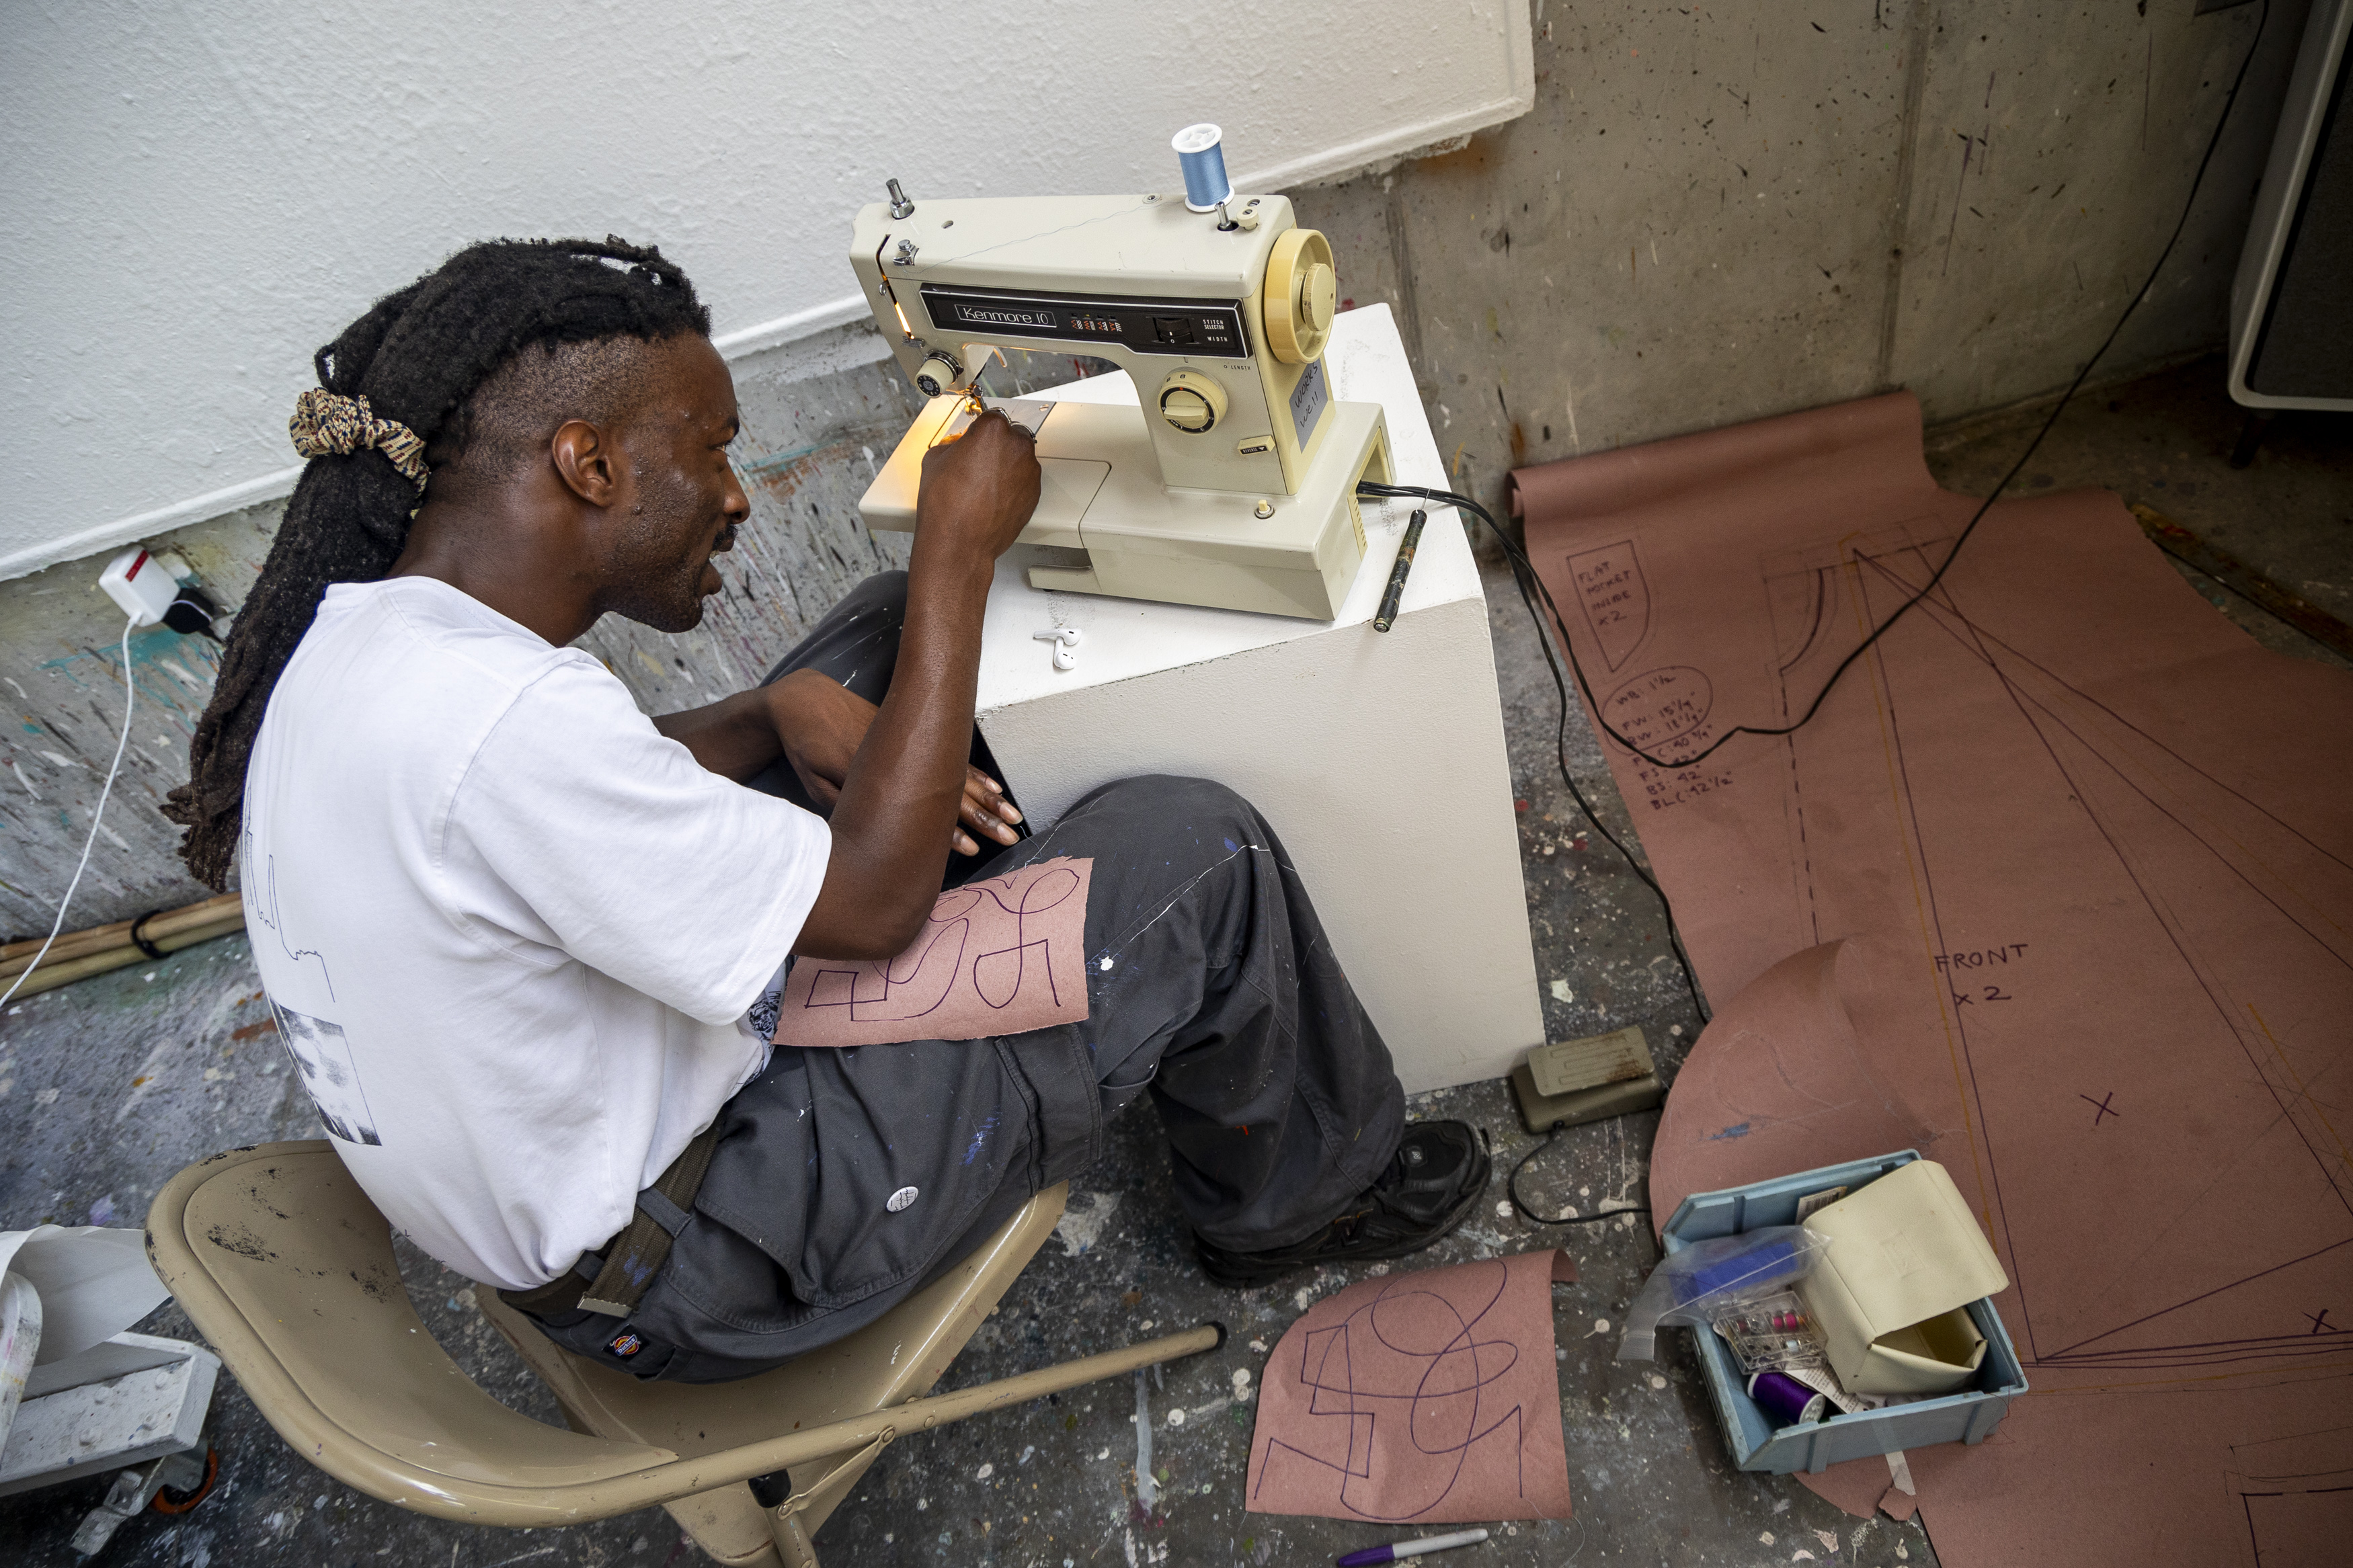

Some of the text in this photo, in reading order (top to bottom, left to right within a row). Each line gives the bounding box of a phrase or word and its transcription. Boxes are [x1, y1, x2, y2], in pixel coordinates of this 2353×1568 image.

[963, 307, 1049, 325] Kenmore 10
[1295, 362, 1318, 408] WORKS
[1578, 561, 1609, 583] FLAT
[1587, 570, 1631, 596] POCKET
[1933, 943, 2029, 973] FRONT
[617, 1337, 635, 1354] Dickies
